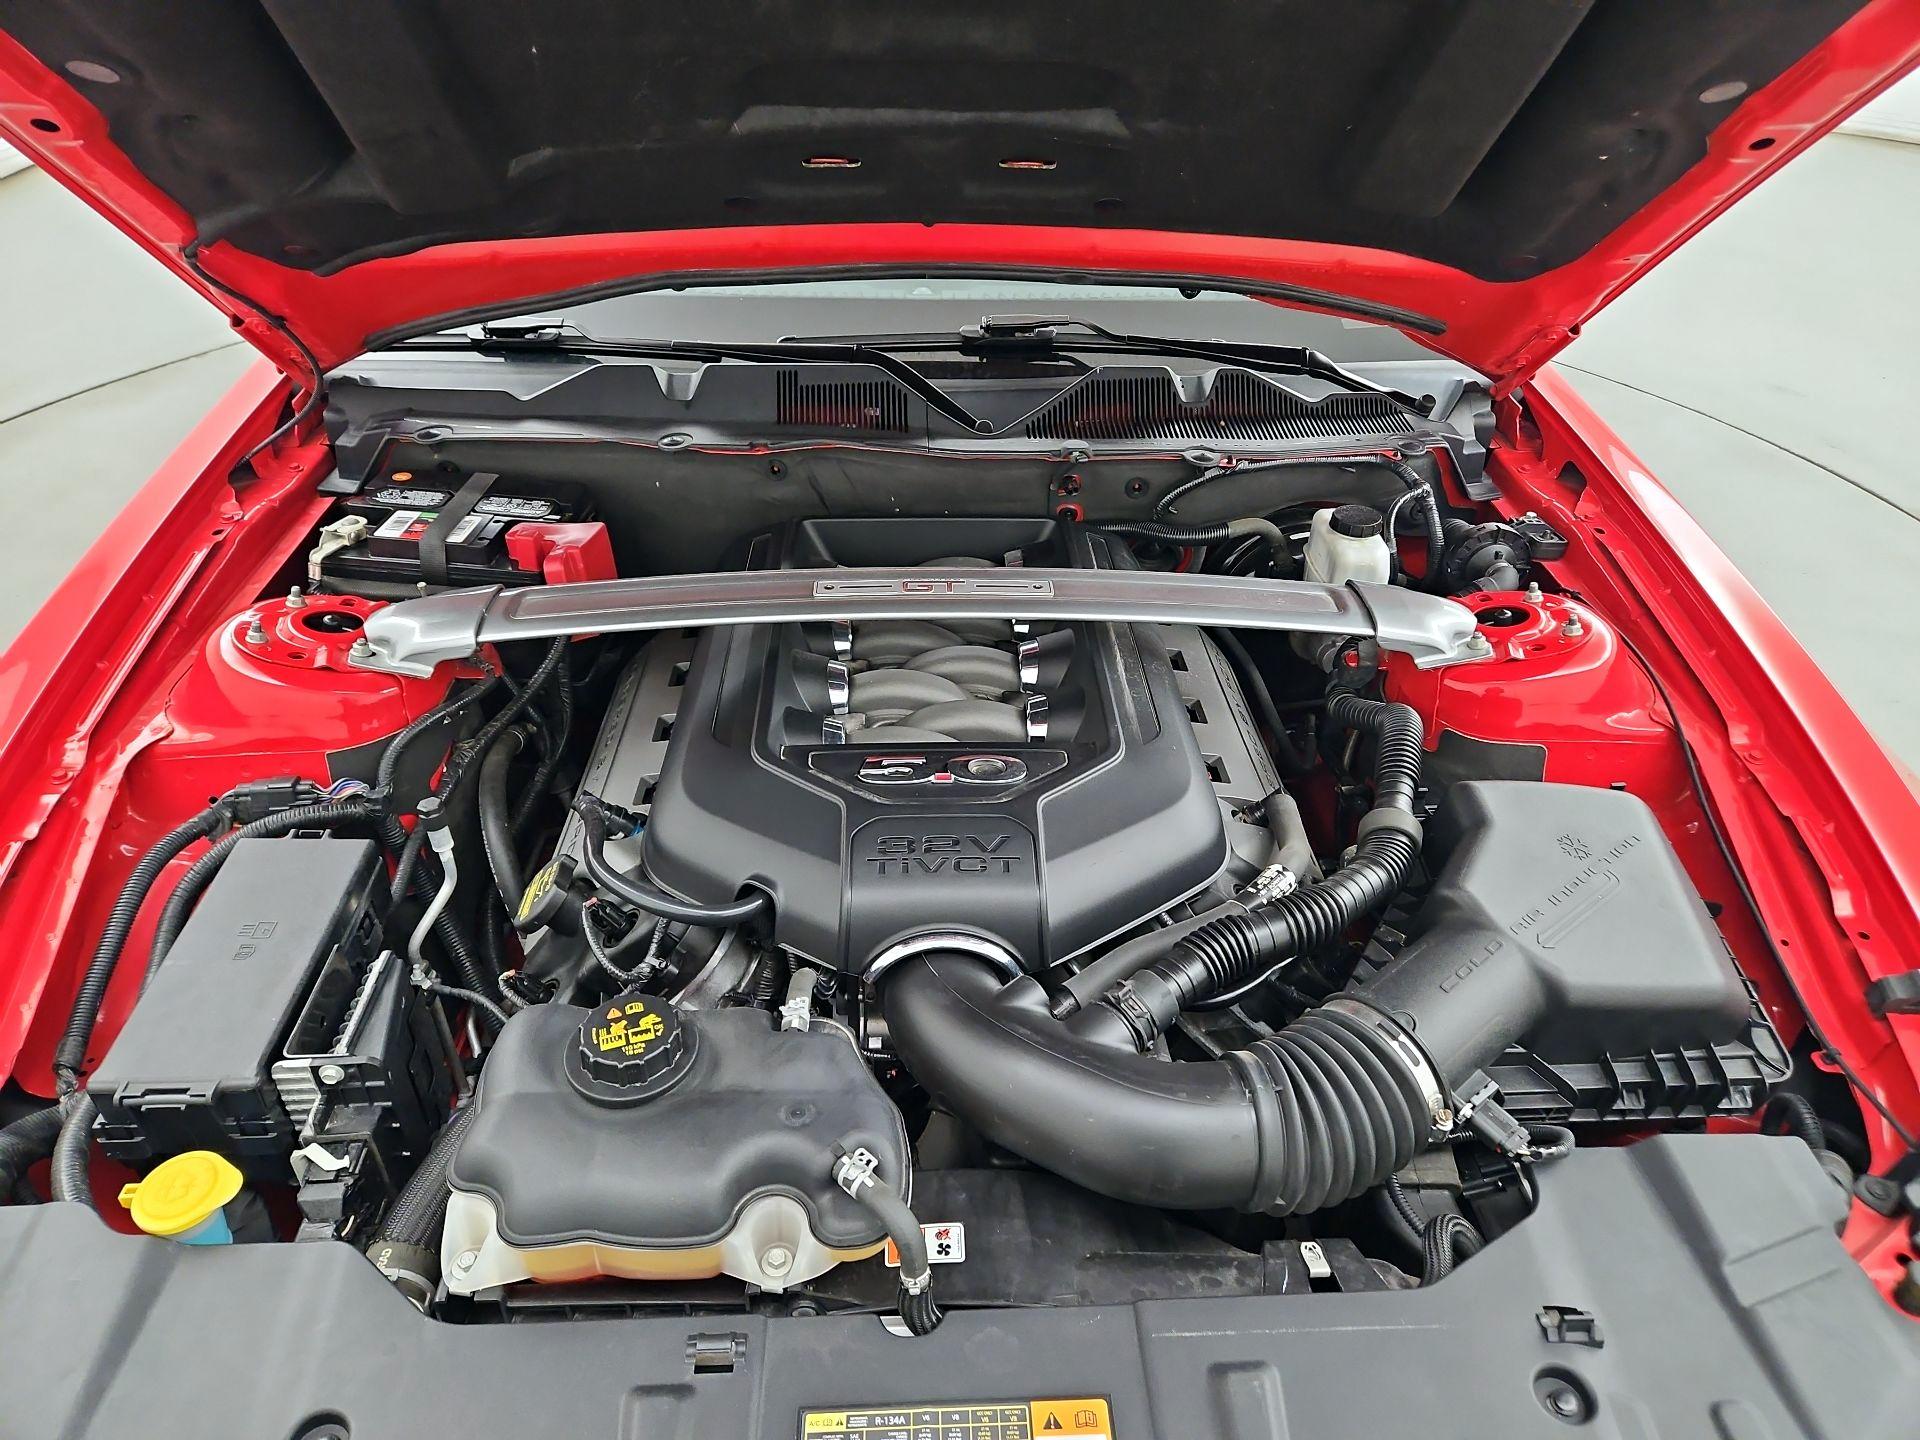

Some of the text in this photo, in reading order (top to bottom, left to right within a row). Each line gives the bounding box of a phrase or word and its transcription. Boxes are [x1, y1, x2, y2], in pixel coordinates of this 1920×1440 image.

[902, 579, 966, 593] GT
[857, 755, 1028, 784] 5.0
[876, 835, 1011, 854] 32V
[1439, 937, 1504, 994] COLD
[1509, 908, 1545, 935] AIR
[874, 1415, 906, 1426] R-134A
